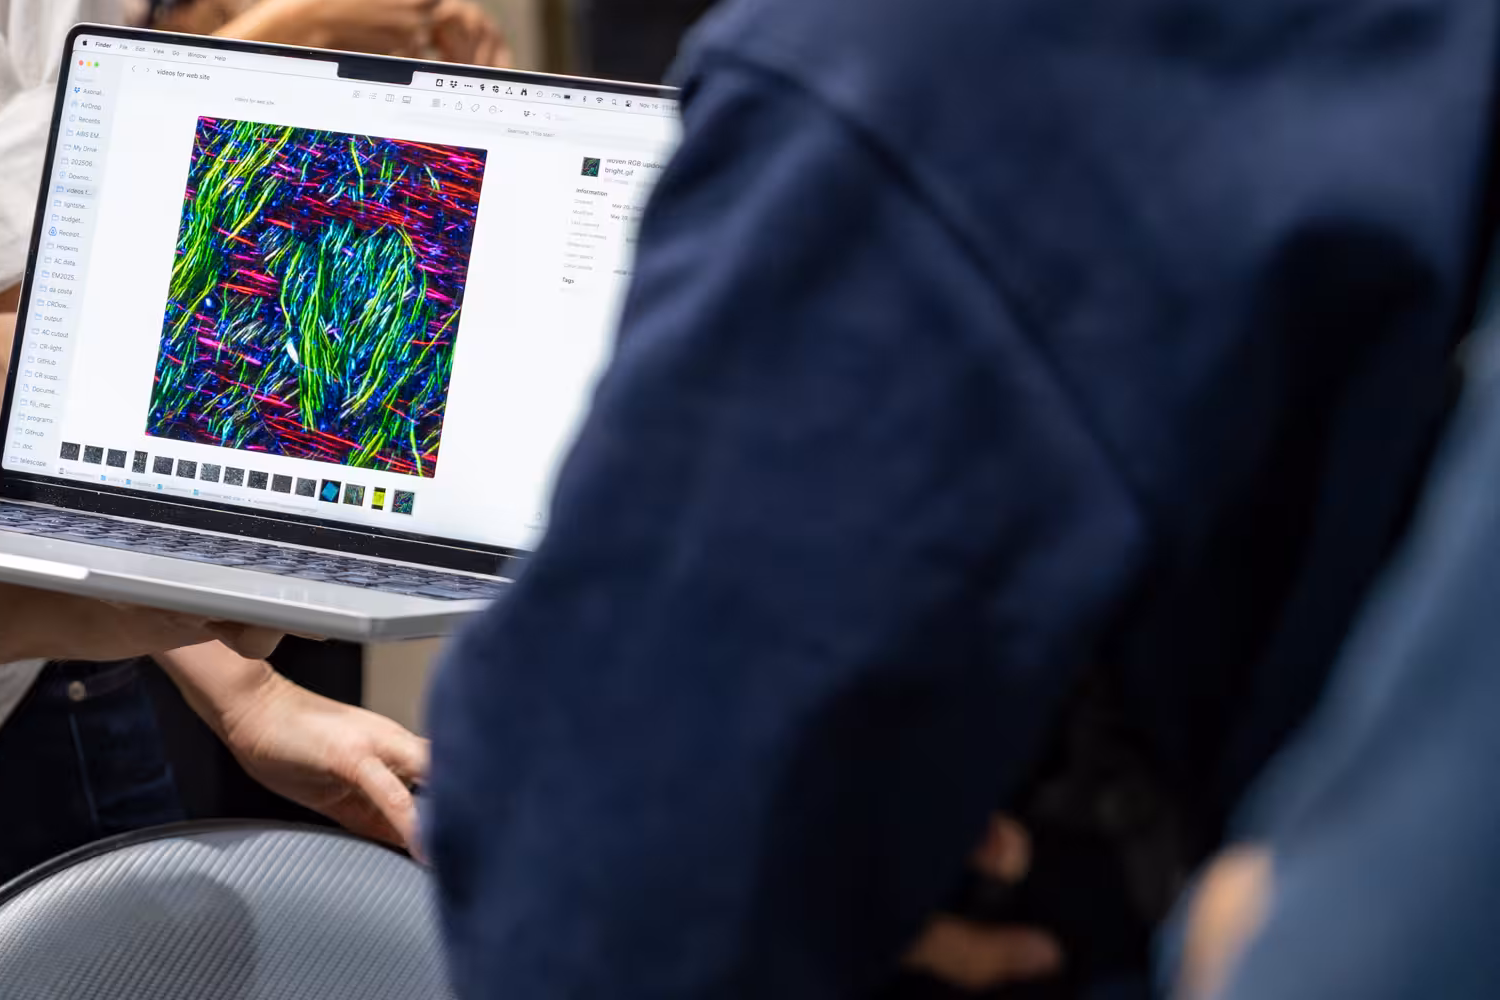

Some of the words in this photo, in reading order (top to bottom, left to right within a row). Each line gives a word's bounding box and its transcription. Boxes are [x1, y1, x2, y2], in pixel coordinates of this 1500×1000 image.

[94, 41, 112, 49] Finder
[187, 51, 208, 60] Window
[156, 68, 176, 77] videos
[176, 70, 186, 78] for
[186, 72, 199, 80] web
[199, 73, 211, 81] site
[80, 102, 102, 111] AirDrop
[78, 116, 101, 125] Recents
[73, 144, 82, 152] My
[83, 145, 98, 153] Drive
[606, 158, 627, 166] woven
[627, 159, 642, 167] RGB
[604, 167, 634, 177] bright.gif
[66, 186, 84, 195] videos
[575, 187, 608, 197] Information
[56, 244, 79, 252] Hopkins
[562, 276, 575, 284] Tags
[57, 287, 73, 295] costa
[44, 315, 63, 323] output
[37, 357, 57, 366] GitHub
[34, 371, 43, 379] CR
[29, 400, 51, 409] fiji_mac
[27, 415, 53, 424] programs
[20, 457, 47, 467] telescope
